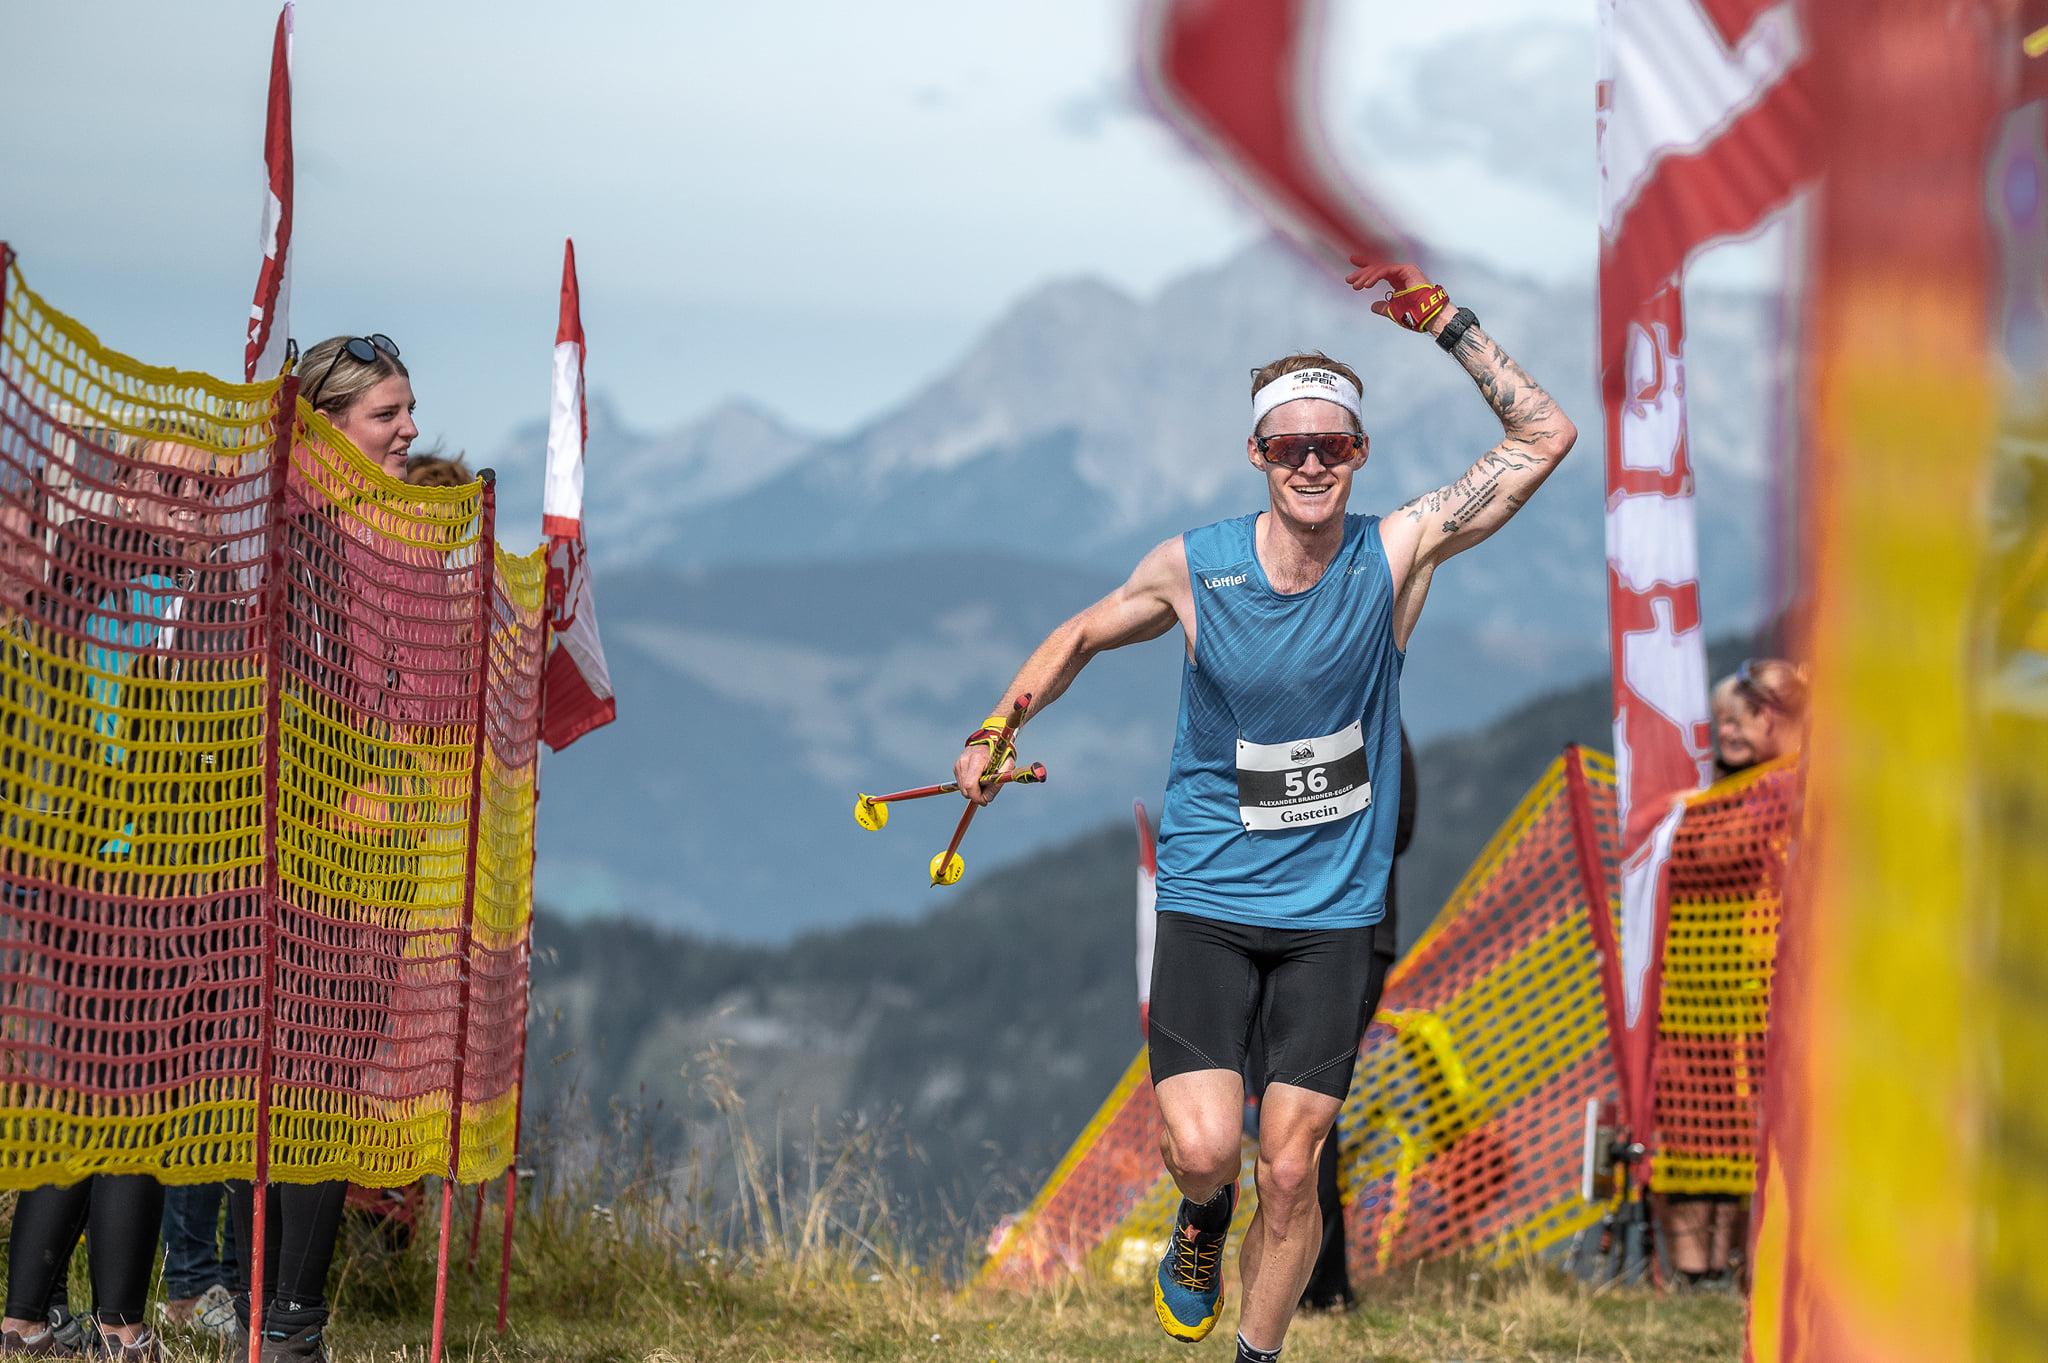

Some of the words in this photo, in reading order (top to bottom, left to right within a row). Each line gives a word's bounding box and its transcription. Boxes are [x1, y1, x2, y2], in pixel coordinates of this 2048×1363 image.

[1293, 371, 1338, 381] SILBER
[1301, 376, 1336, 387] PFEIL
[1284, 767, 1328, 797] 56
[1259, 798, 1298, 807] ALEXANDER
[1298, 784, 1354, 803] BRANDNER-EGGER
[1281, 805, 1339, 823] Gastein
